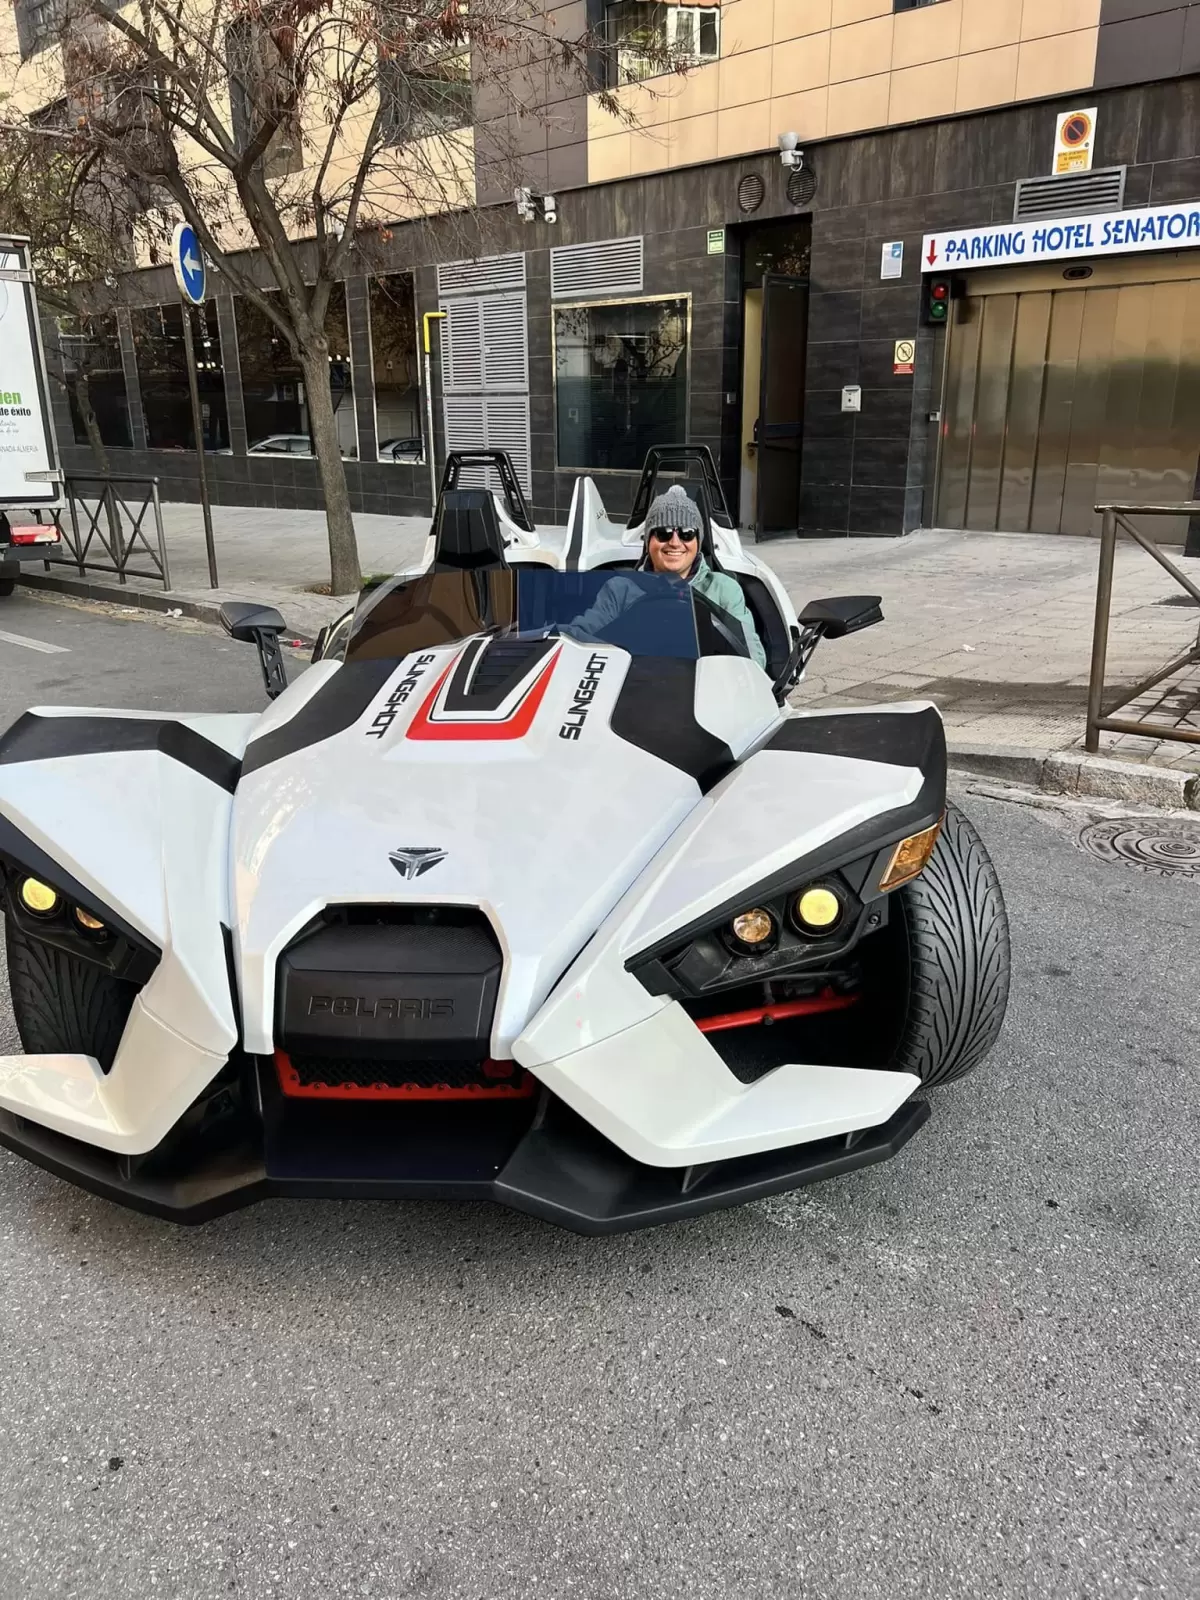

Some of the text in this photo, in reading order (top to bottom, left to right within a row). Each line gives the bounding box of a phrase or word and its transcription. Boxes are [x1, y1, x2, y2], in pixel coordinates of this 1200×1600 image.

[945, 211, 1200, 262] PARKING HOTEL SENATOR
[11, 407, 31, 416] éxito
[365, 653, 436, 739] SLINGSHOT
[558, 653, 609, 740] SLINGSHOT
[307, 995, 455, 1019] POLARIS
